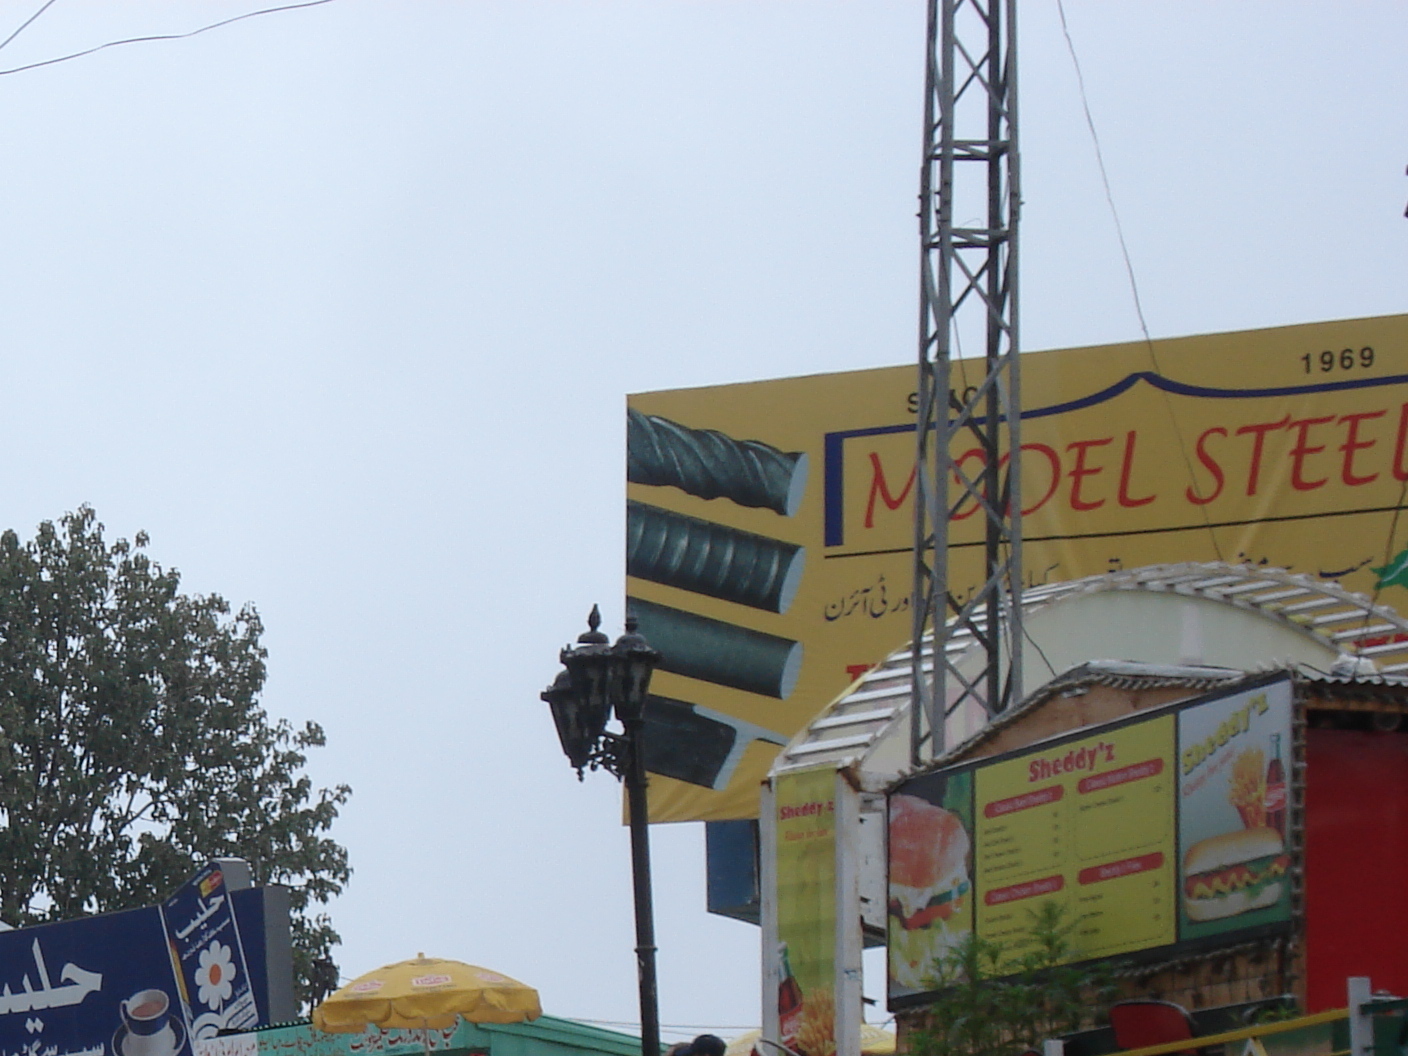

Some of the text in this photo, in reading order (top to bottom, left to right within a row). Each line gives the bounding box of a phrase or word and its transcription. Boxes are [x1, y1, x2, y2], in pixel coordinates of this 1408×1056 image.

[1300, 346, 1375, 374] 1969
[863, 430, 1157, 529] MODEL
[1028, 742, 1115, 783] Sheddy'z
